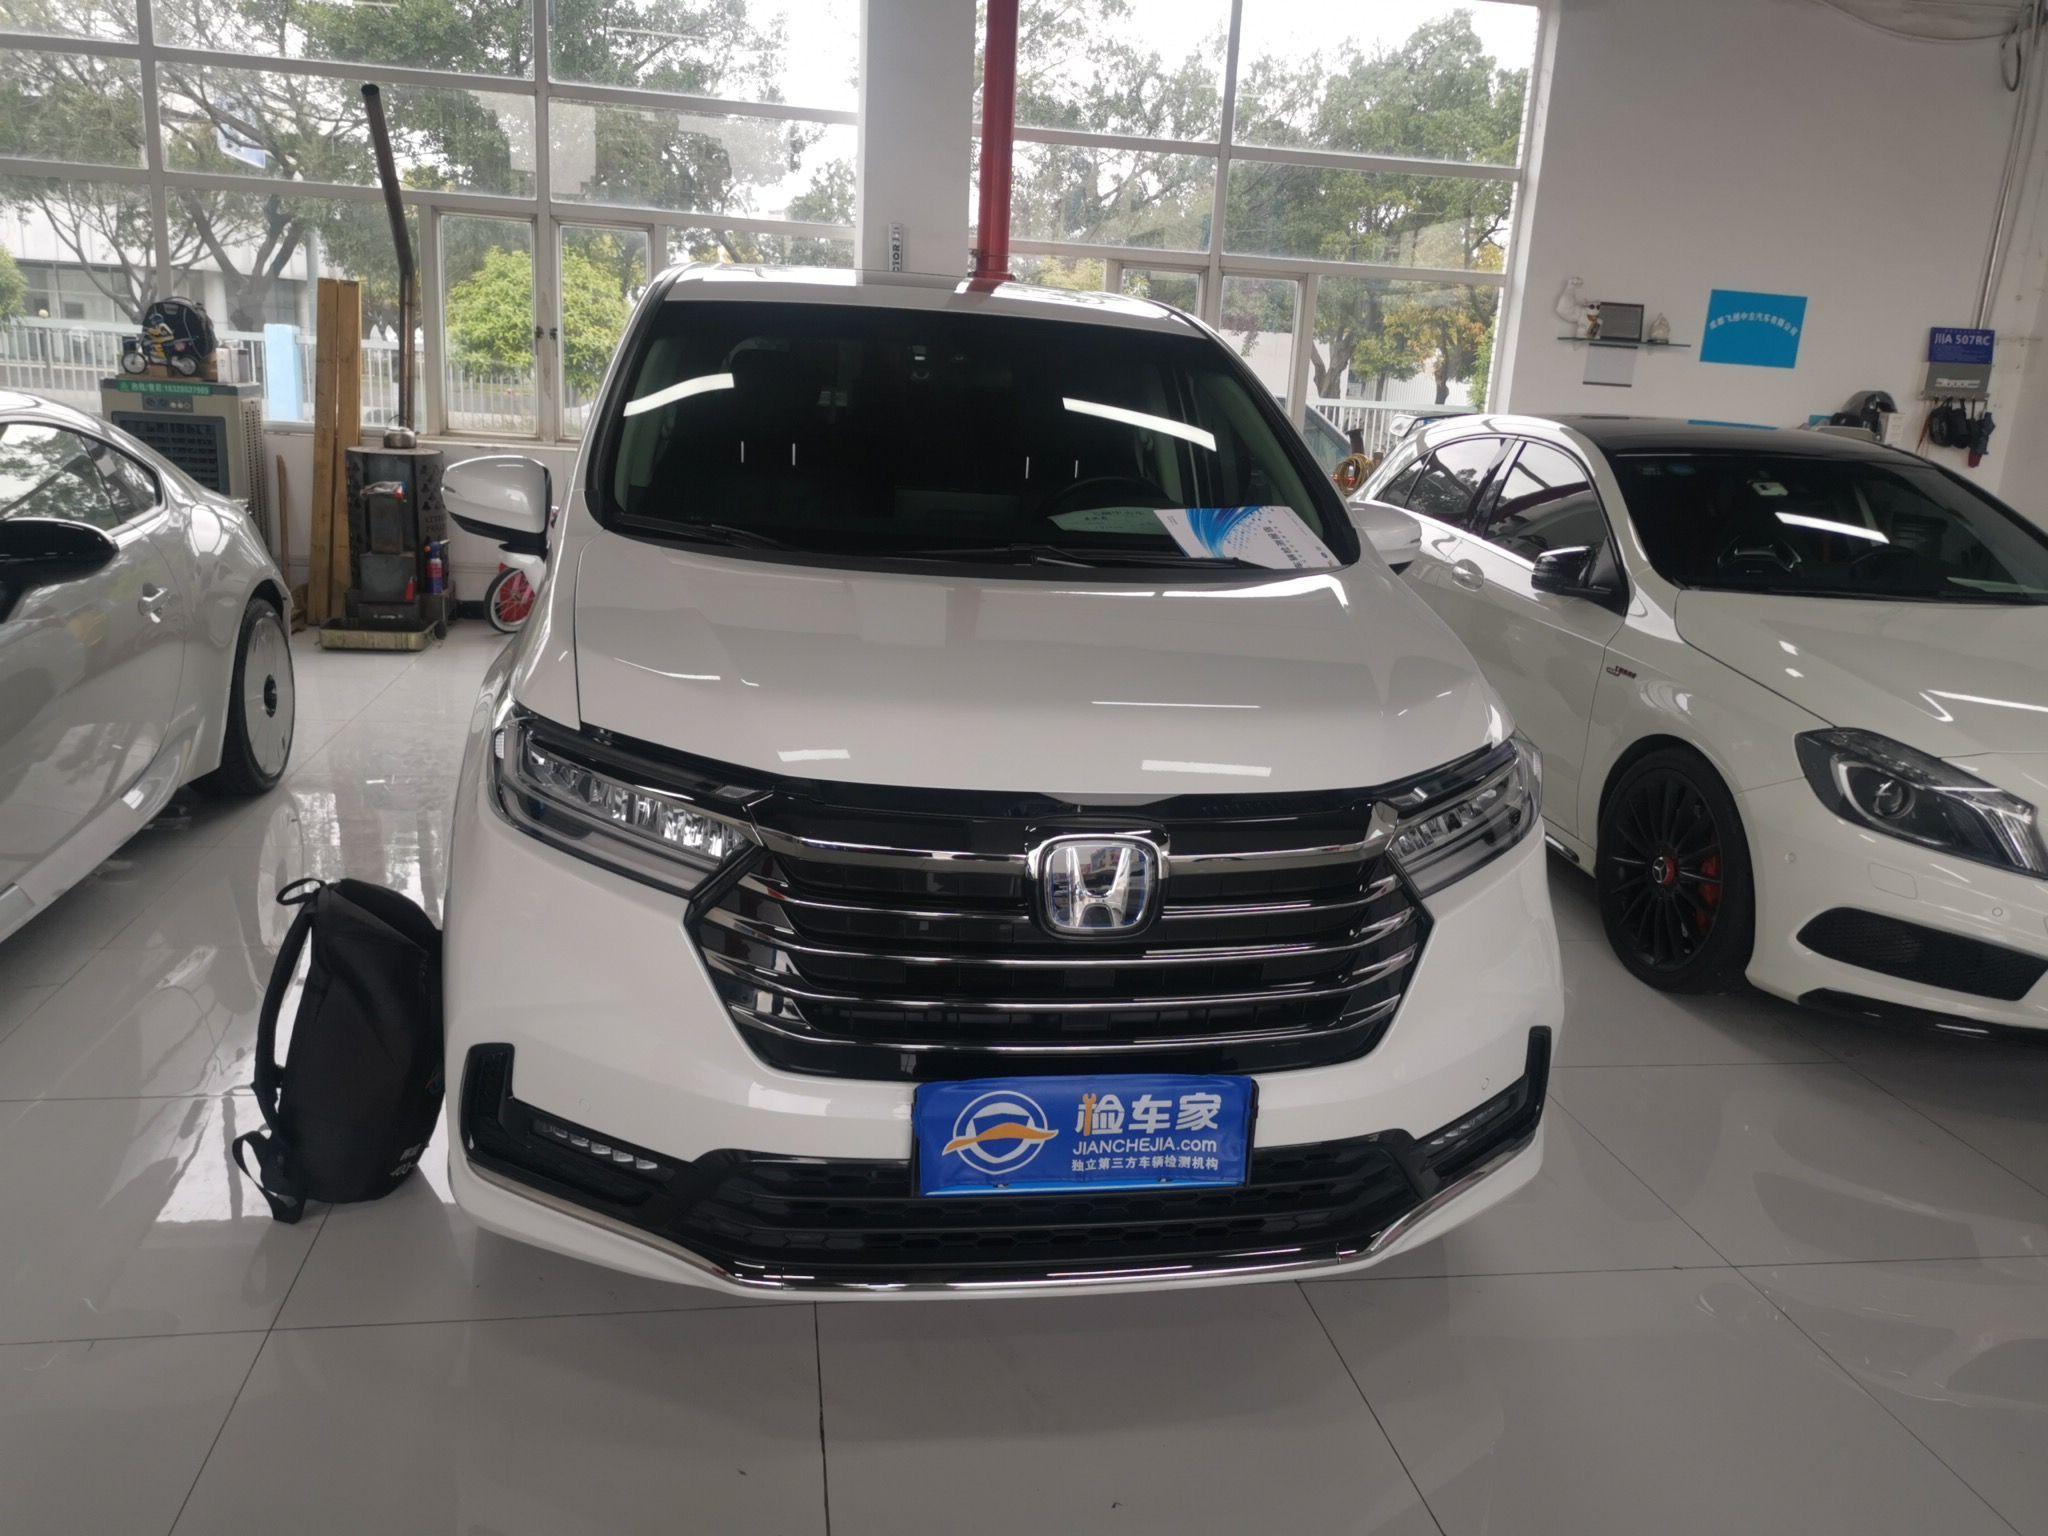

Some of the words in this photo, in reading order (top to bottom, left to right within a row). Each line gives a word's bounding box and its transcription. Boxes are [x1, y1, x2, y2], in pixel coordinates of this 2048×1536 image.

[1955, 334, 1991, 346] 507RC
[1075, 1092, 1221, 1136] 检车家
[1073, 1137, 1217, 1155] JIANCHEJIA.com
[1071, 1155, 1219, 1172] 独立第三方车辆检测机构
